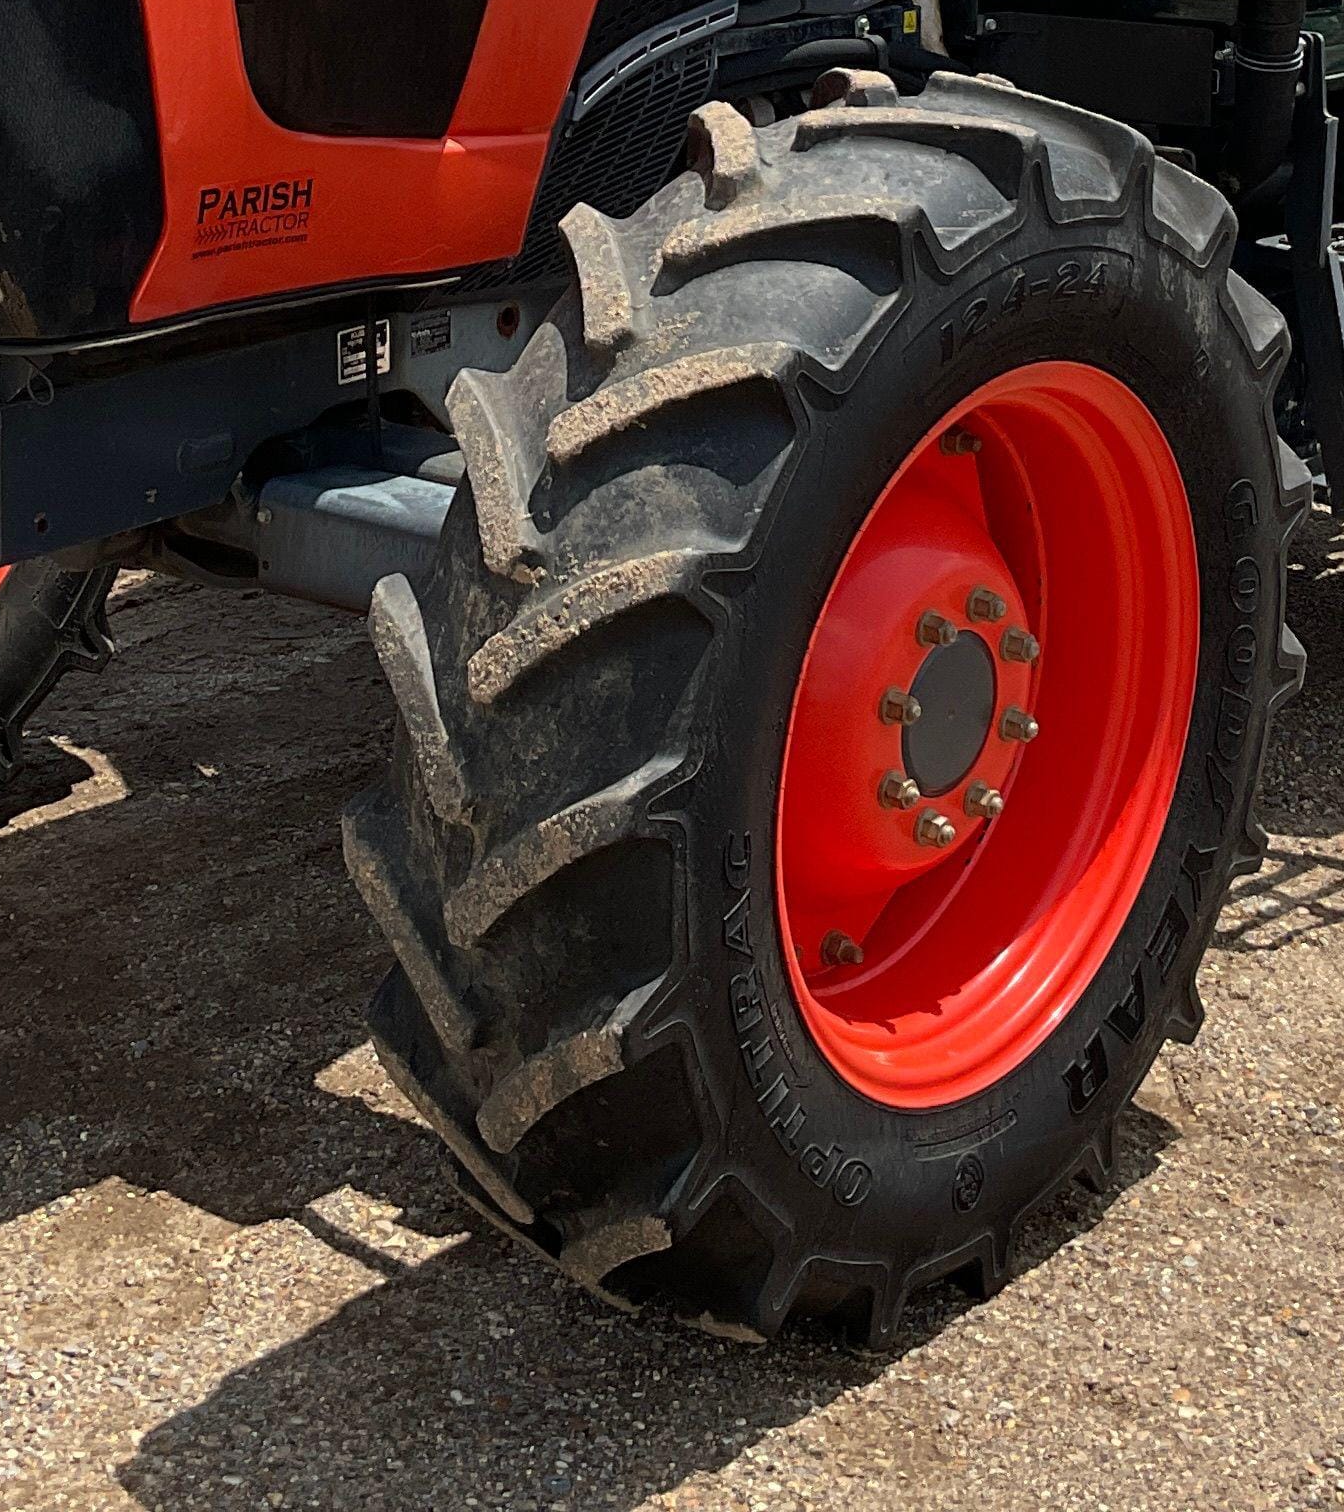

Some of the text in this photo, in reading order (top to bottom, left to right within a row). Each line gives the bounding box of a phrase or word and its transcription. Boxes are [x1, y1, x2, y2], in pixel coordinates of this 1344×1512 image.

[197, 178, 314, 225] PARISH
[227, 211, 310, 239] TRACTOR
[723, 828, 873, 1207] OPTITRAC
